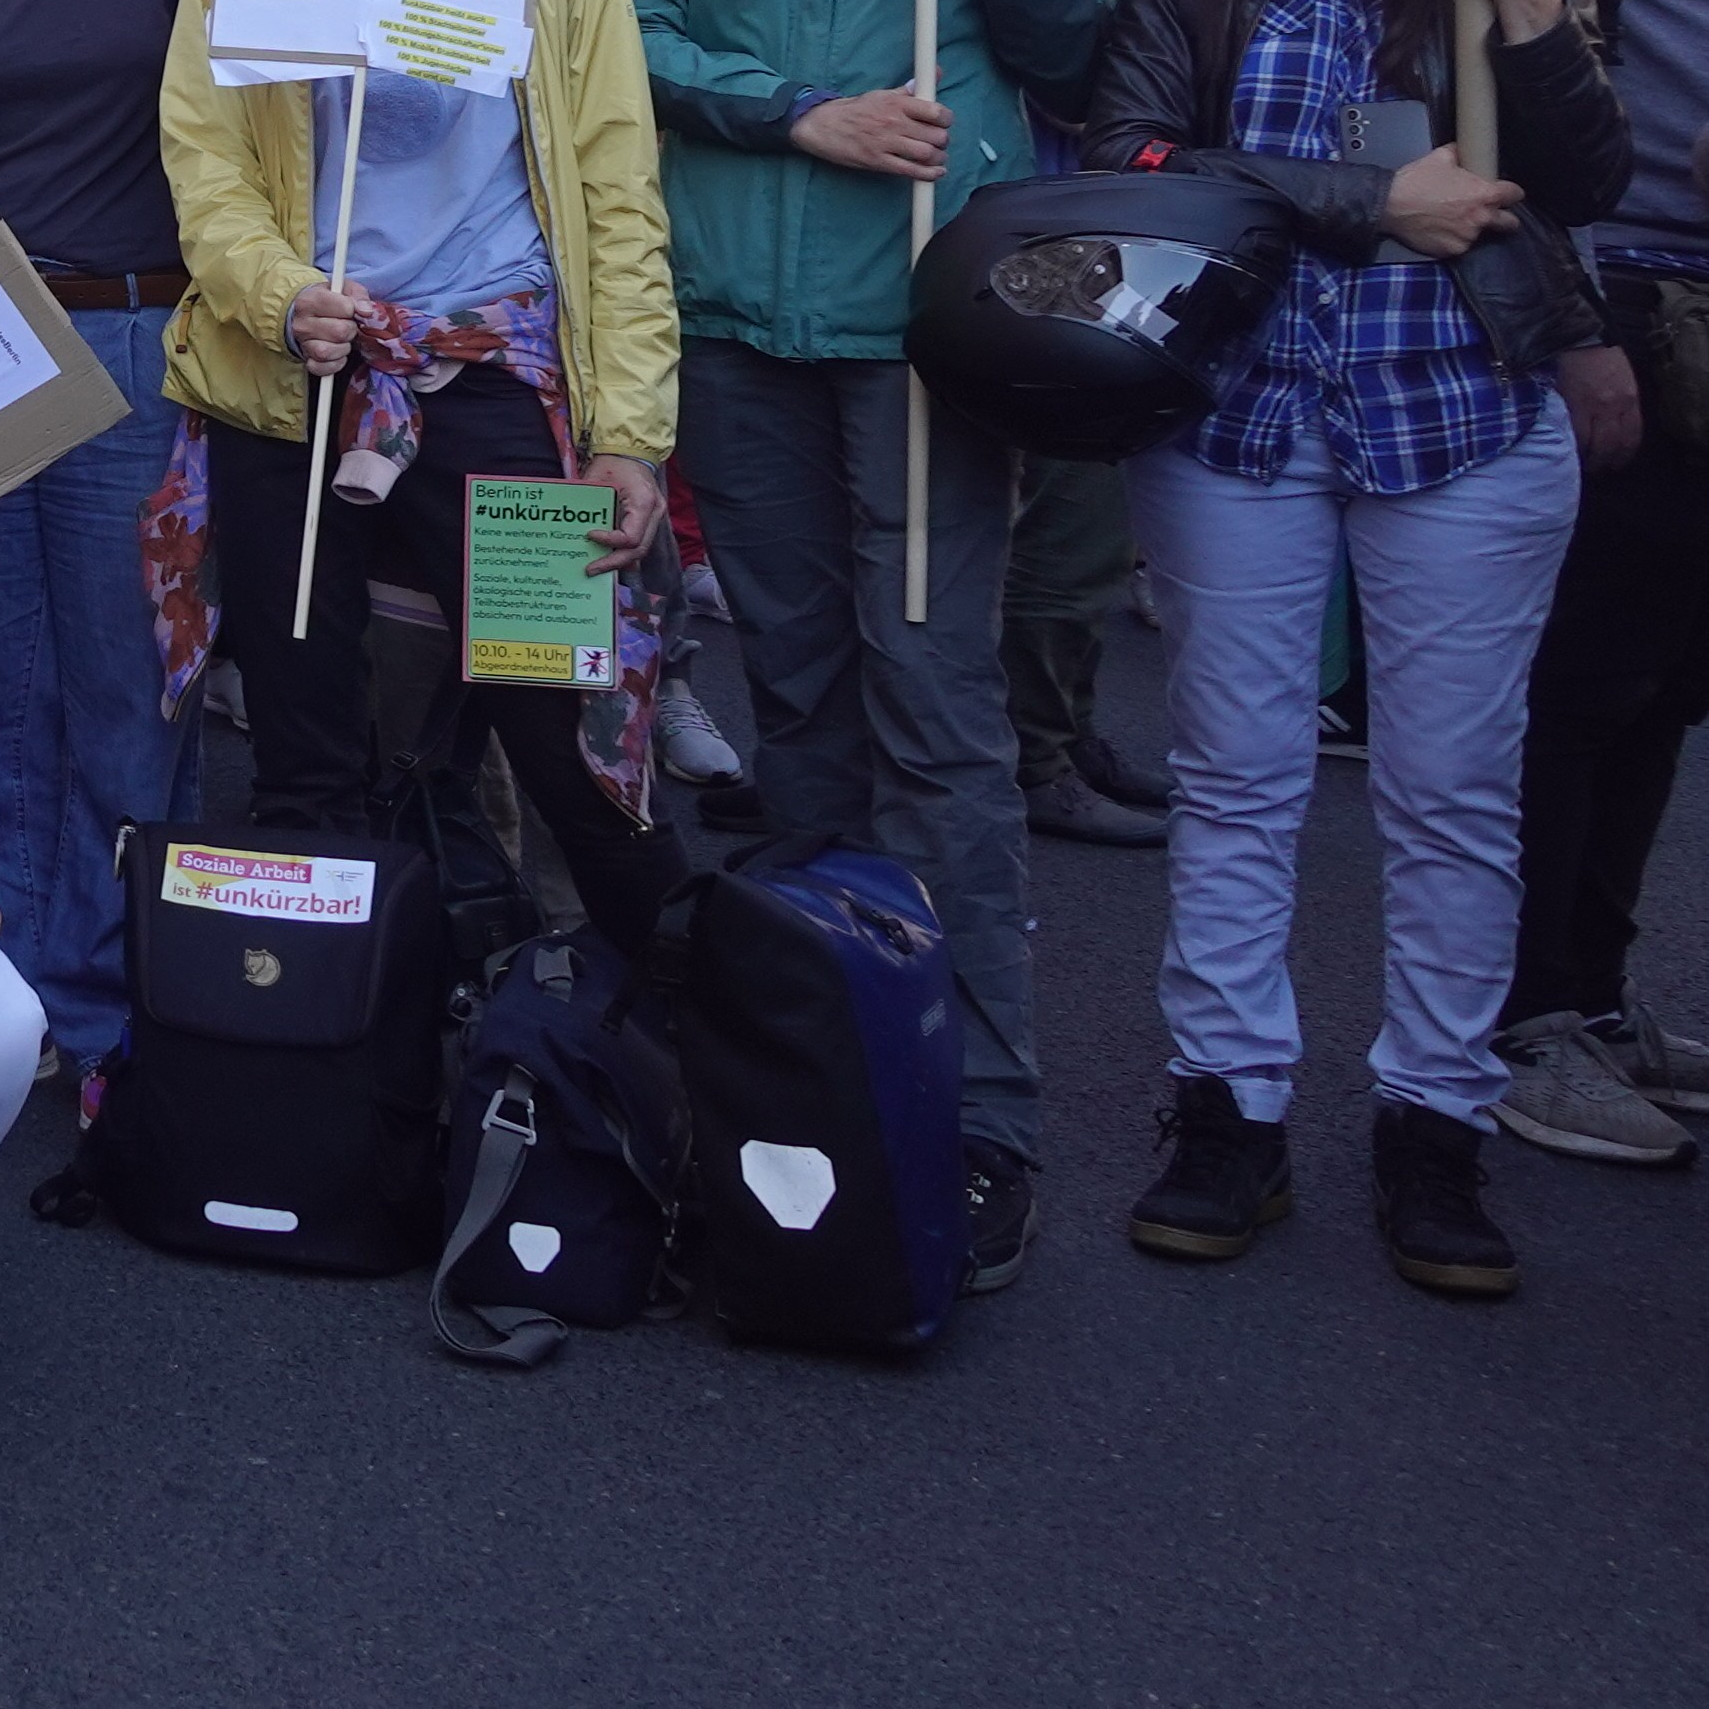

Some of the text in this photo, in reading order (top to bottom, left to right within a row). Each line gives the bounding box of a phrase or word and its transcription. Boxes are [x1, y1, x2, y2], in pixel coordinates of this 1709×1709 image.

[475, 484, 544, 500] Berlin ist
[475, 503, 608, 525] #unkürzbar!
[474, 526, 592, 543] Keine weiteren Kürzung
[474, 543, 589, 559] Bestehende Kürzungen
[533, 589, 553, 598] und
[472, 610, 522, 620] absichern
[523, 613, 543, 622] und
[473, 644, 570, 661] 10.10. 14 Uhr
[470, 660, 568, 674] Abgeordnetenhaus
[182, 853, 307, 881] Soziale Arbeit
[172, 882, 361, 915] ist #unkürzbar!
